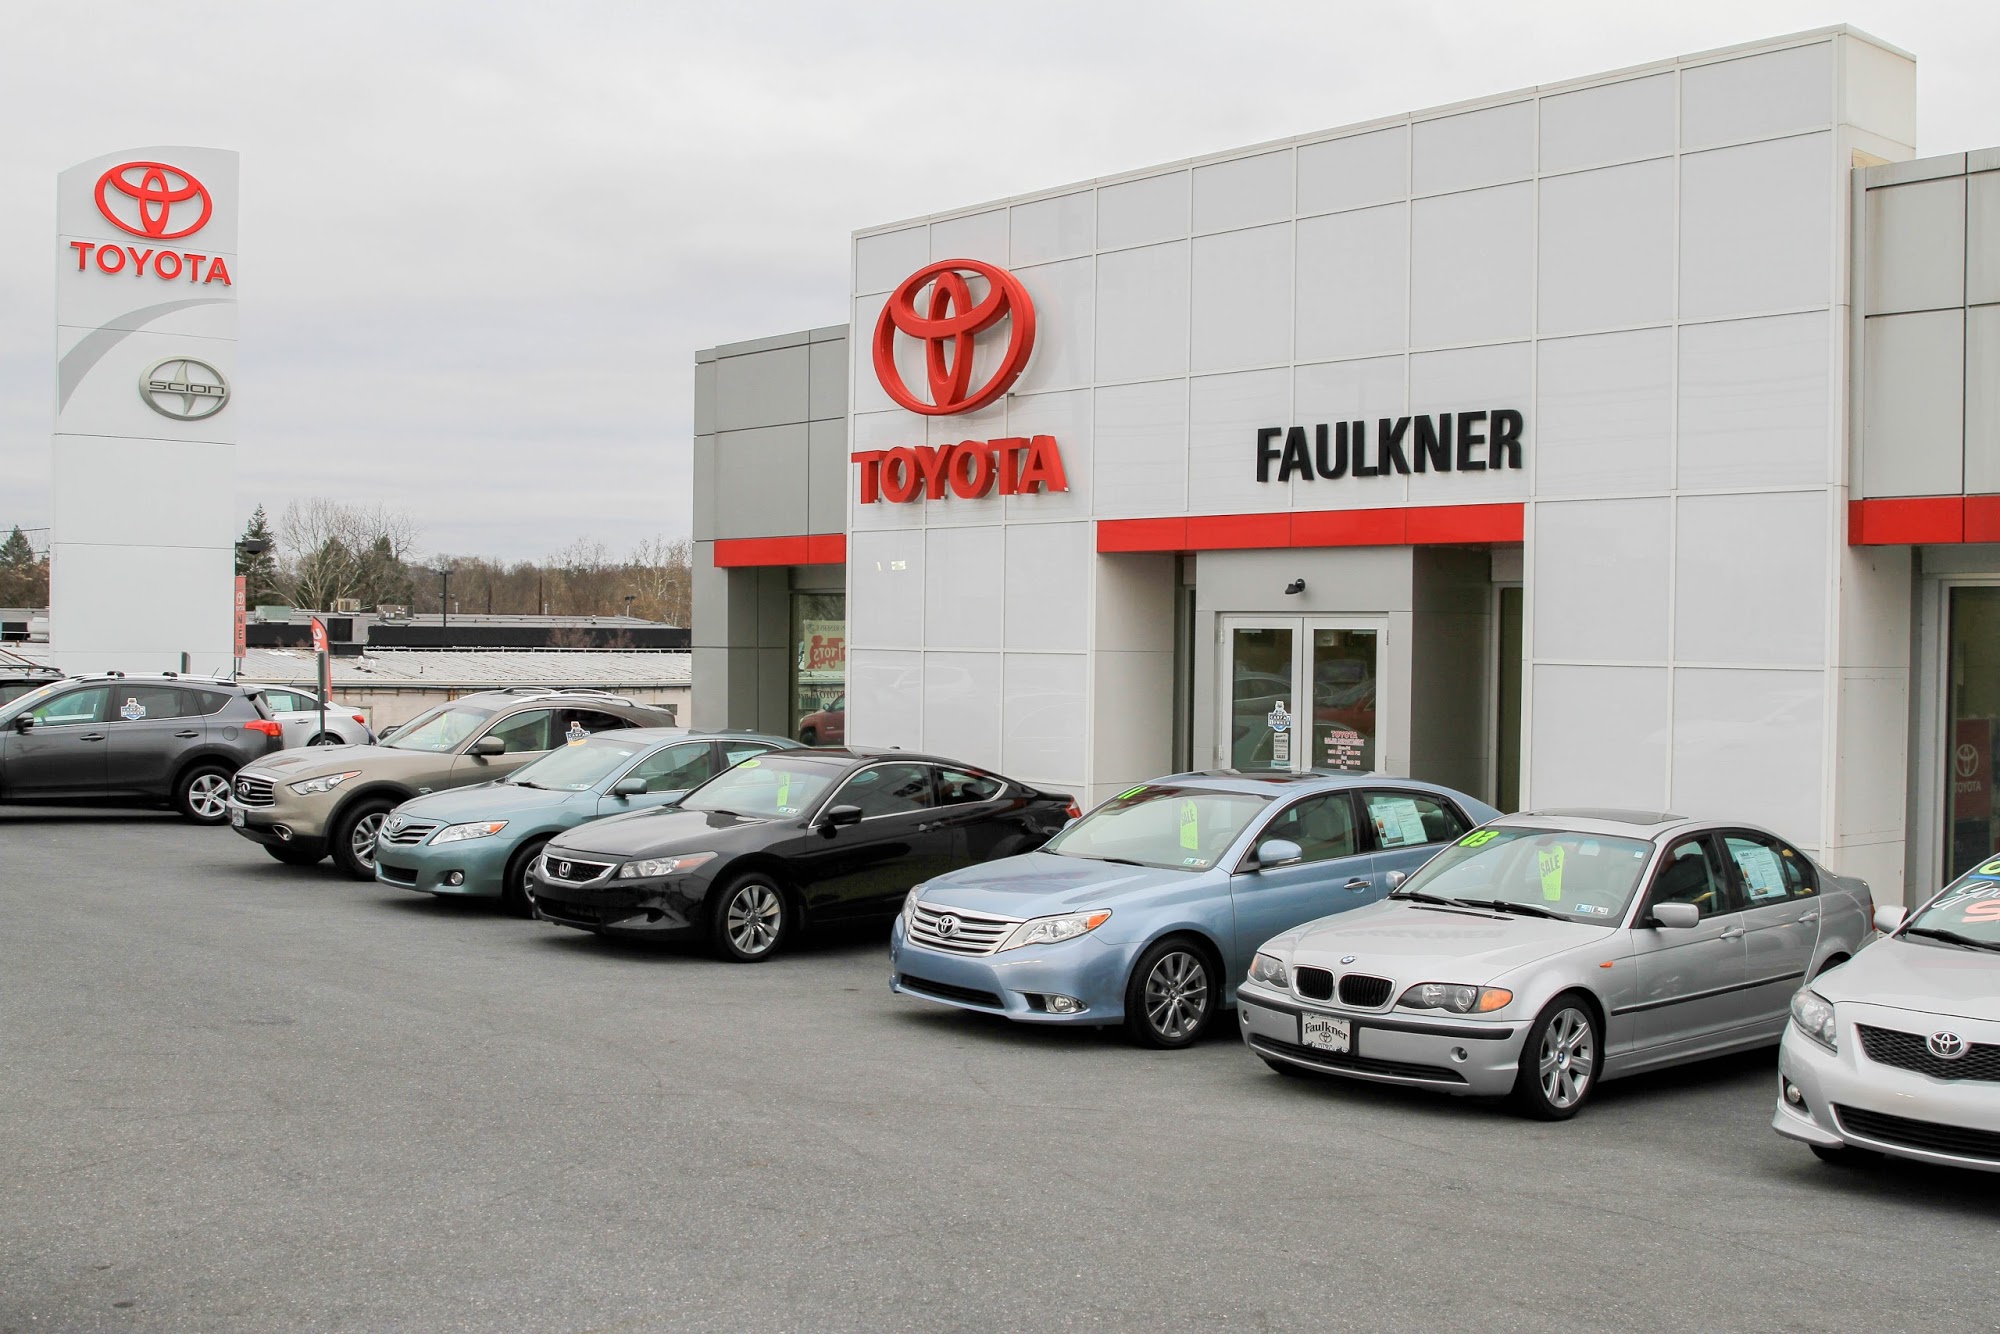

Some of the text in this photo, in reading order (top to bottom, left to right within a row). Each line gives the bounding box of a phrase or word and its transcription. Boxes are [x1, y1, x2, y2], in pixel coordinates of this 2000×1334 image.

[70, 241, 232, 286] TOYOTA
[149, 380, 225, 395] SCION
[1257, 409, 1523, 482] FAULKNER
[851, 434, 1069, 504] TOYOTA
[1459, 830, 1500, 848] 03
[1540, 854, 1561, 877] SALE
[1305, 1021, 1348, 1041] Faulkner
